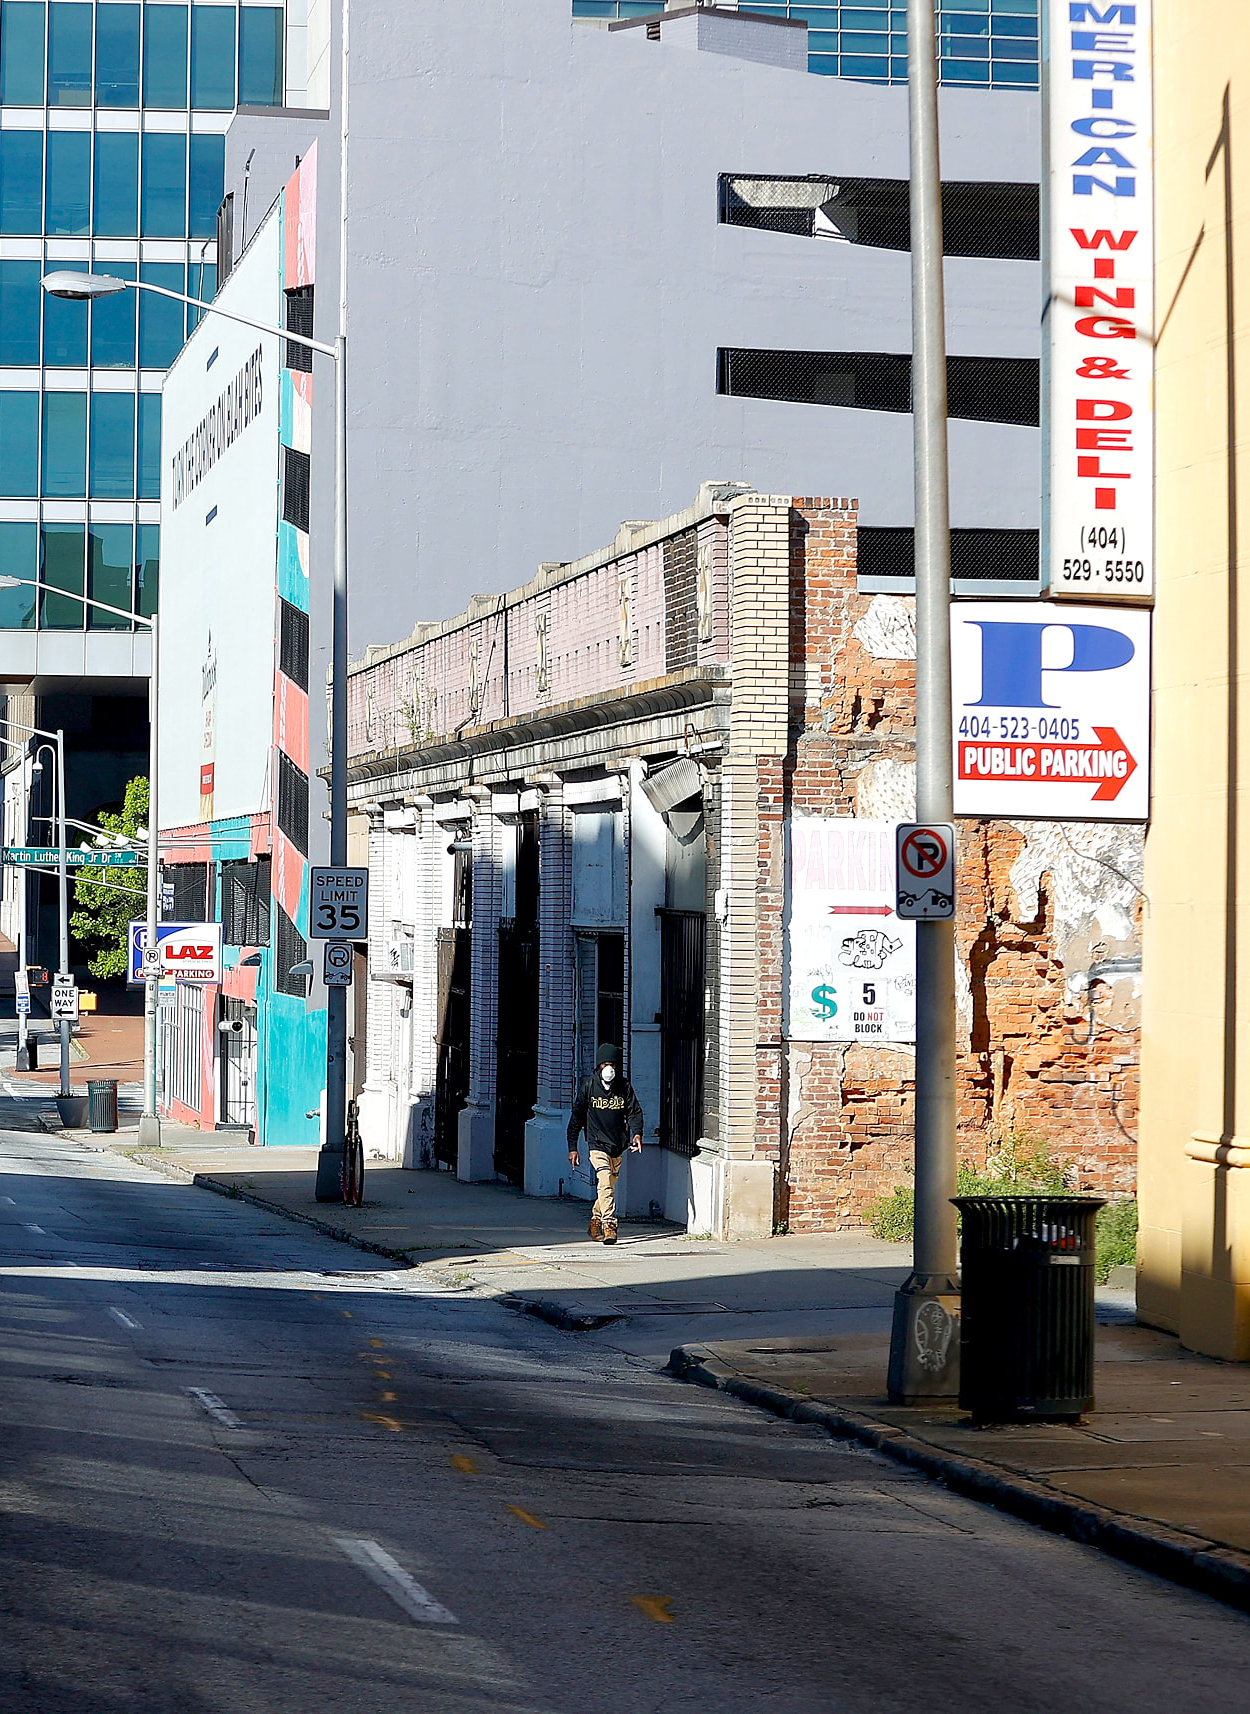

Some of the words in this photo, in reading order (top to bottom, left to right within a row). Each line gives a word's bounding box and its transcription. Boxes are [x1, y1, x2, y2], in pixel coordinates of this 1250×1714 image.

[1068, 2, 1137, 197] MERICAN
[1068, 228, 1138, 339] WING
[1075, 356, 1133, 380] &
[217, 390, 226, 461] ON
[244, 342, 263, 429] BITES
[1075, 398, 1134, 510] DELI
[1080, 526, 1126, 555] (404)
[962, 620, 1136, 709] P
[958, 715, 1081, 741] 404-523-0405
[963, 746, 1037, 777] PUBLIC
[1040, 748, 1129, 779] PARKING
[2, 850, 31, 861] Martin
[34, 851, 61, 862] Luthe
[66, 851, 85, 865] King
[88, 853, 98, 863] Jr
[101, 852, 112, 863] Dr
[793, 830, 895, 892] PARKIN
[316, 875, 364, 887] SPEED
[321, 890, 358, 902] LIMIT
[316, 904, 360, 931] 35
[165, 945, 214, 960] LAZ
[172, 970, 213, 978] PARKING
[54, 989, 75, 998] ONE
[54, 999, 75, 1007] WAY
[811, 983, 838, 1022] $
[862, 982, 876, 1005] 5
[853, 1011, 865, 1022] DO
[867, 1011, 884, 1022] NOT
[854, 1023, 882, 1033] BLOCK
